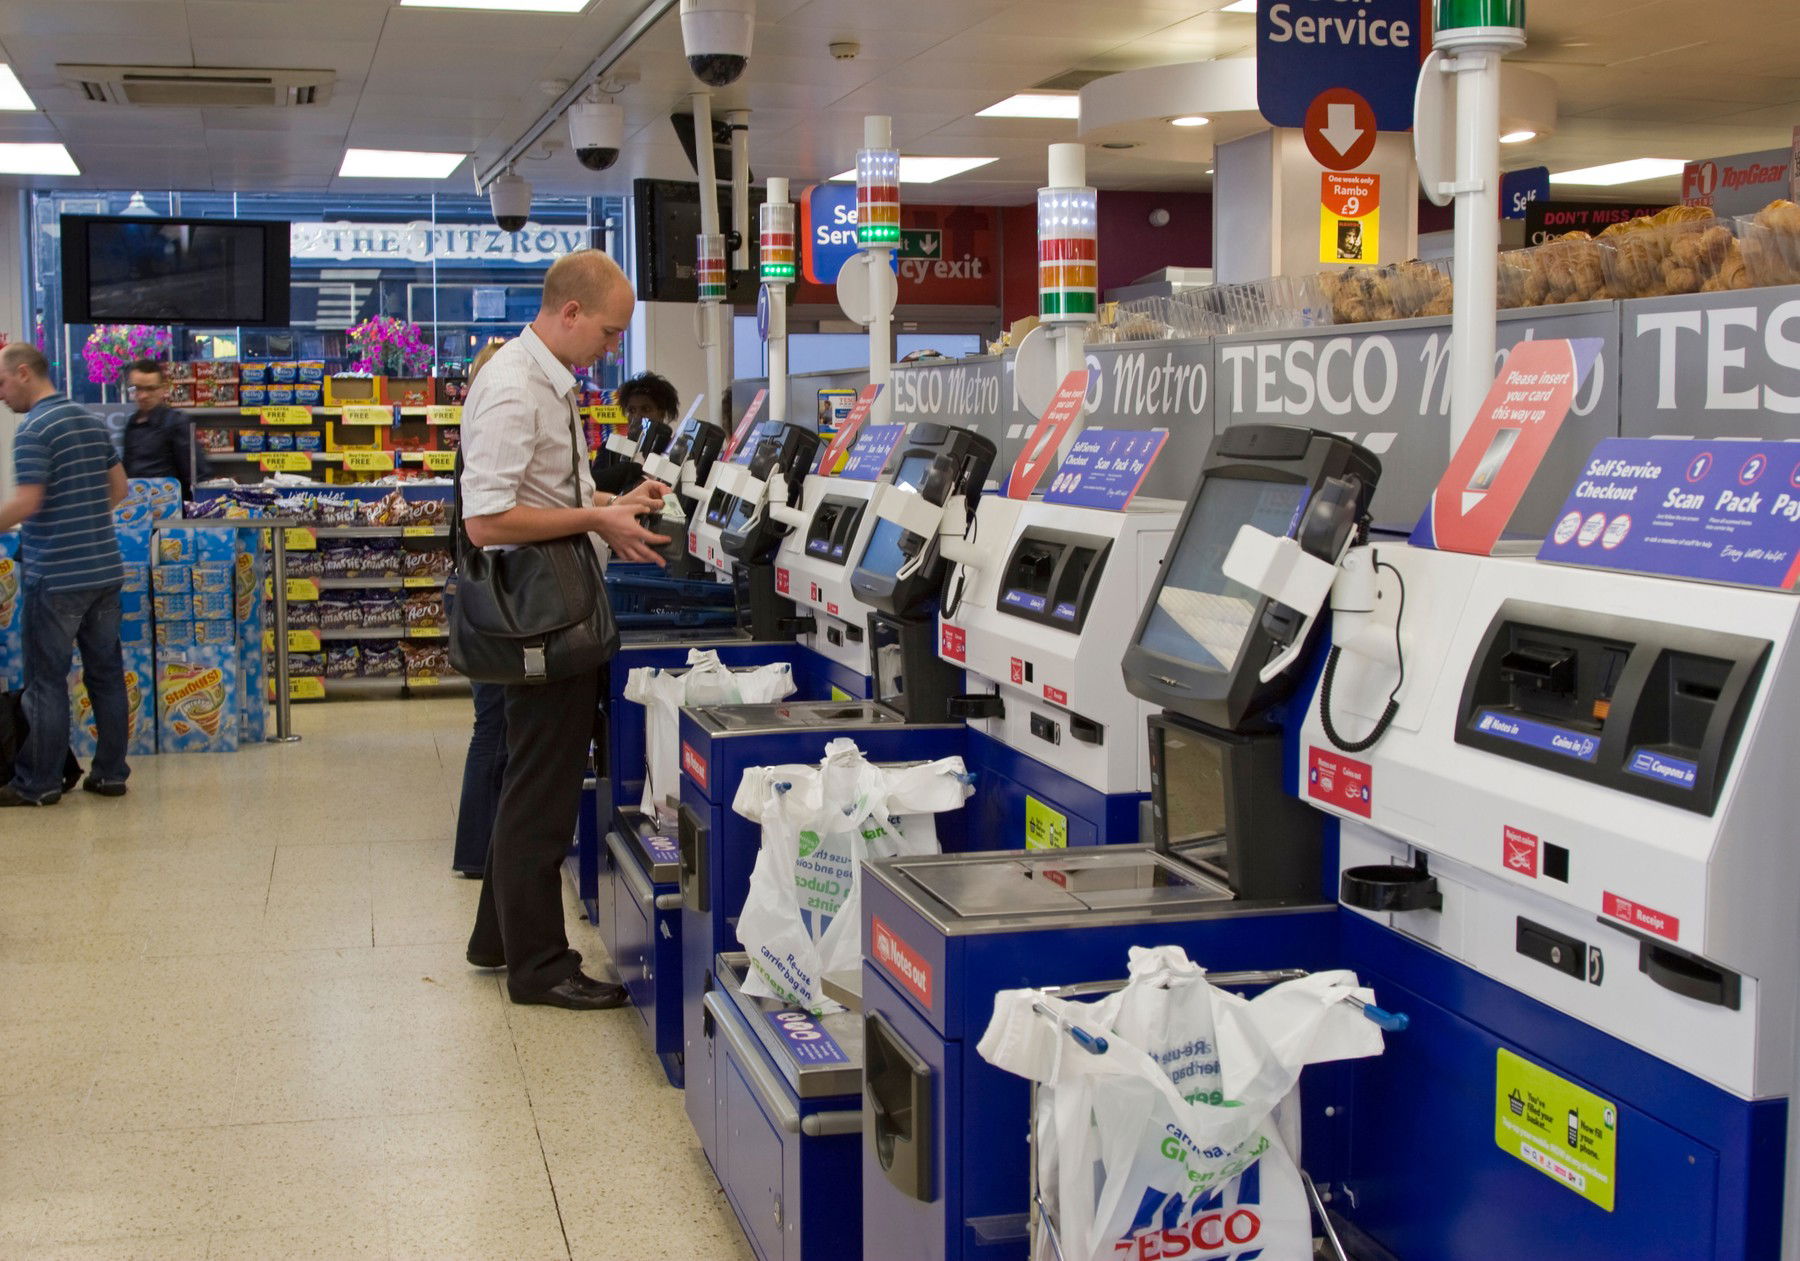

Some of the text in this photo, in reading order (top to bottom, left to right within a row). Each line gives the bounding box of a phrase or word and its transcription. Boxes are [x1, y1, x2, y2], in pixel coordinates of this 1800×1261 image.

[1268, 4, 1410, 47] Service
[1328, 175, 1375, 186] One week only
[1334, 184, 1368, 196] Rambo
[1683, 161, 1718, 199] F1
[1722, 163, 1787, 191] TopGear
[1341, 196, 1359, 215] £9
[1512, 189, 1537, 212] Self
[1544, 211, 1588, 225] DON'T
[1592, 209, 1630, 223] MISS
[327, 228, 400, 254] THE
[934, 253, 982, 279] exit
[1113, 352, 1207, 416] Metro
[1222, 334, 1398, 416] TESCO
[1505, 371, 1570, 384] Please insert
[948, 367, 999, 415] Metro
[1502, 387, 1554, 405] your card
[1491, 405, 1546, 424] this way up
[1586, 458, 1760, 479] Self Service 1 2
[1575, 480, 1637, 501] Checkout
[1663, 487, 1705, 509] Scan
[1715, 490, 1762, 513] Pack
[1491, 719, 1519, 734] Notes in
[1552, 734, 1581, 751] Coins in
[1651, 760, 1694, 782] Coupons in
[1636, 909, 1664, 931] Receipt
[761, 945, 786, 972] carrier
[784, 969, 801, 991] bag
[890, 939, 927, 993] Notes out
